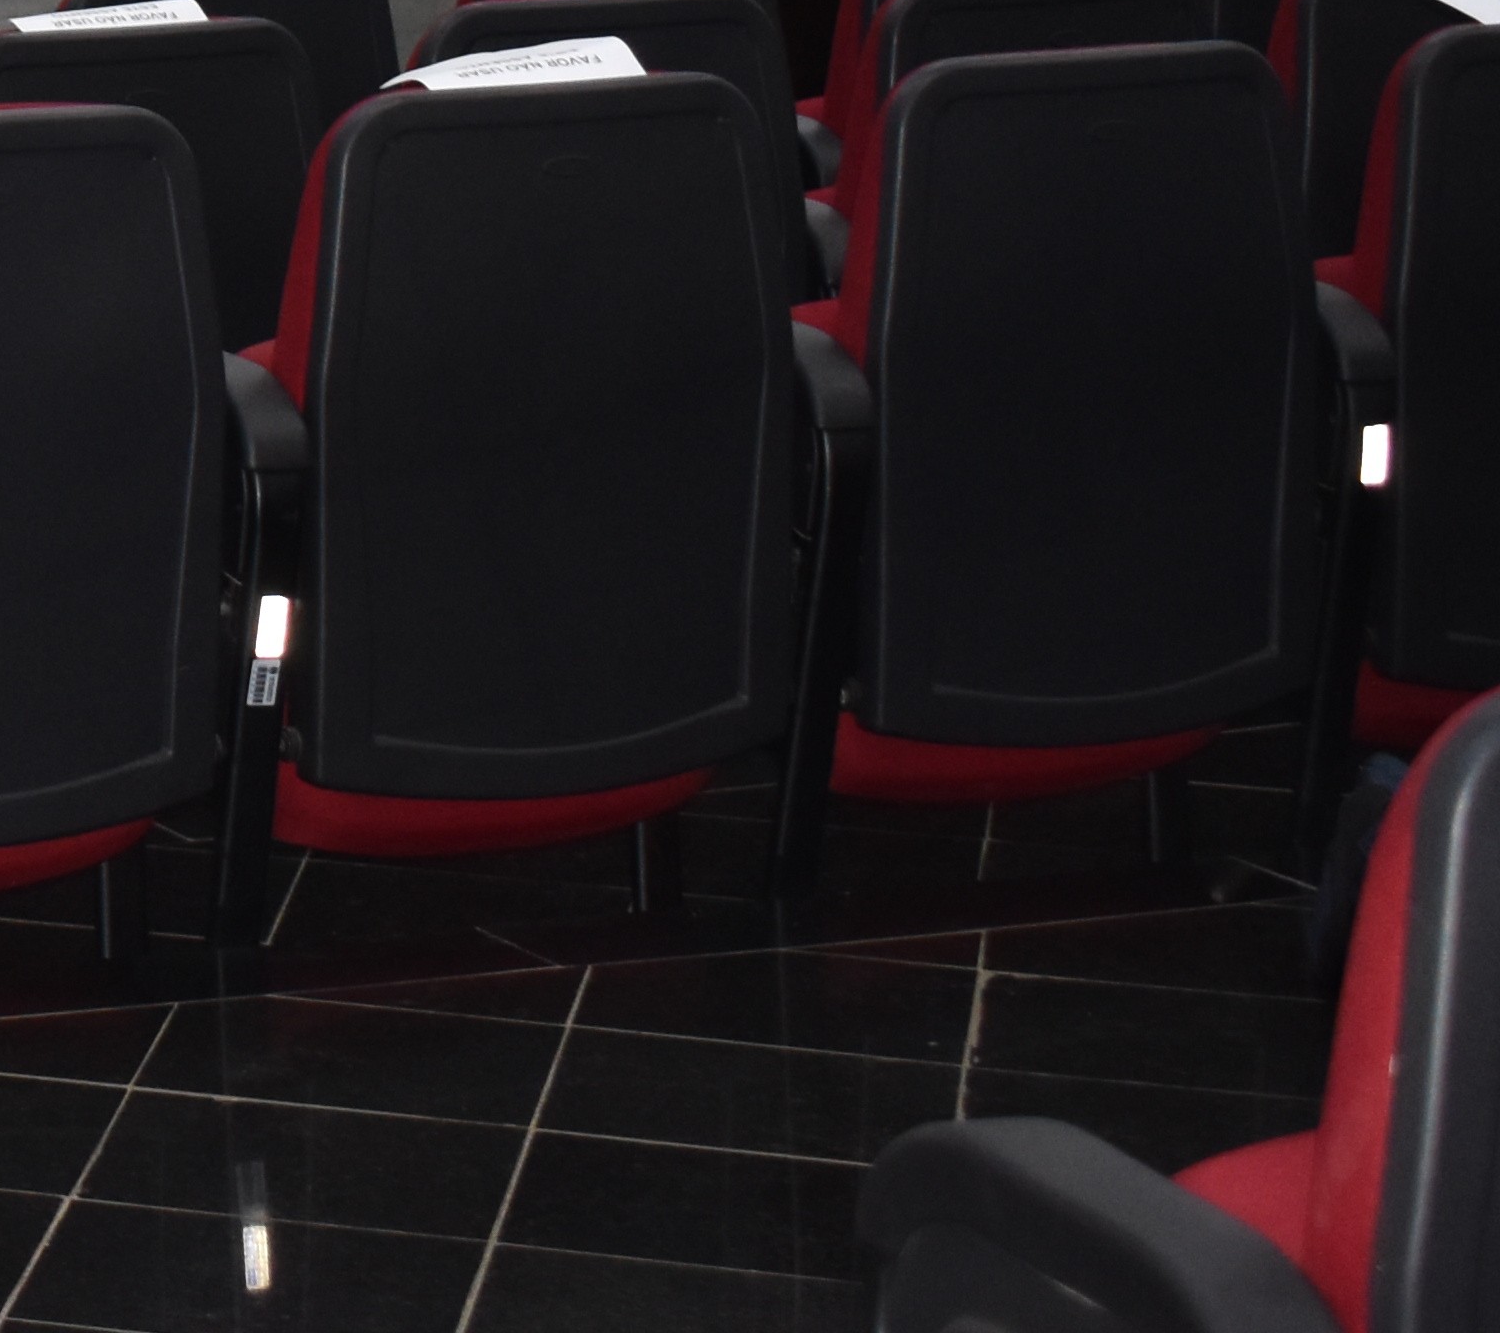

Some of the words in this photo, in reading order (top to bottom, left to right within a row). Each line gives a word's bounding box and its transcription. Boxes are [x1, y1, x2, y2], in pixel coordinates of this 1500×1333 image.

[53, 16, 91, 28] USAR
[95, 14, 125, 25] NÃO
[130, 10, 178, 21] FAVOR
[507, 58, 541, 72] NÃO
[545, 53, 603, 67] FAVOR
[455, 64, 503, 78] USAR
